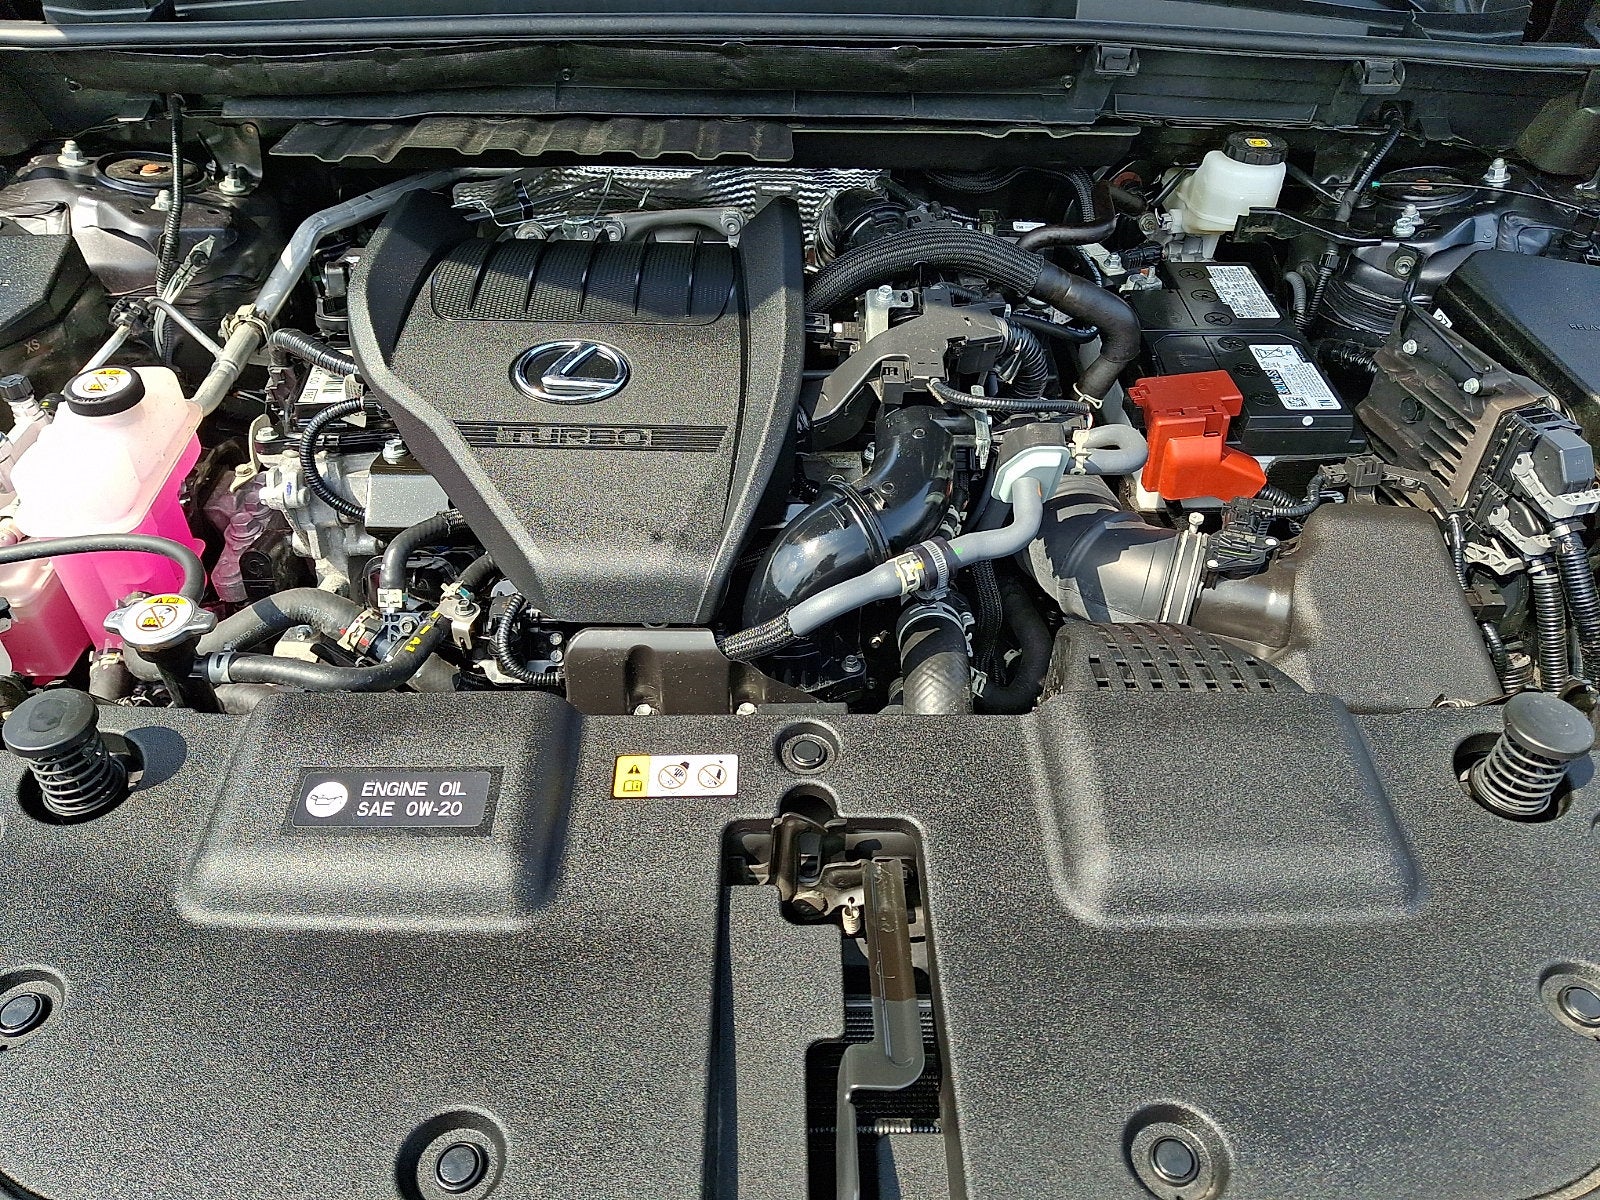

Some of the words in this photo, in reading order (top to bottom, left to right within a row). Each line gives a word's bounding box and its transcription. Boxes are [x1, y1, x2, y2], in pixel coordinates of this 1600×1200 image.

[500, 426, 649, 446] TURBO
[361, 781, 429, 797] ENGINE
[438, 781, 467, 797] OIL
[356, 801, 396, 817] SAE
[405, 801, 463, 817] 0W-20
